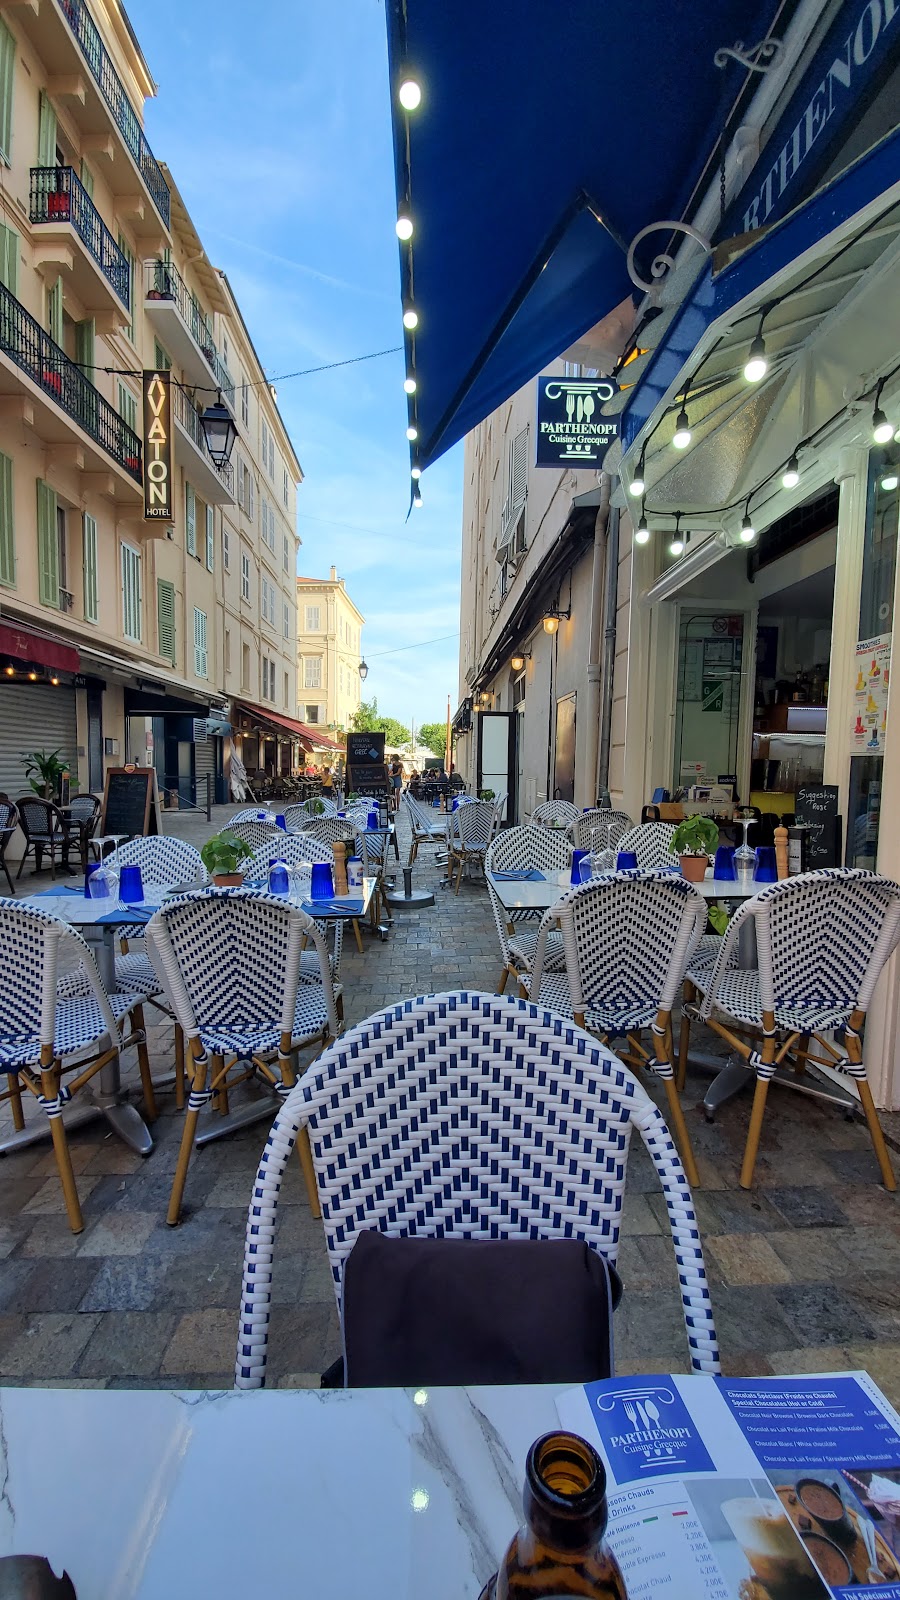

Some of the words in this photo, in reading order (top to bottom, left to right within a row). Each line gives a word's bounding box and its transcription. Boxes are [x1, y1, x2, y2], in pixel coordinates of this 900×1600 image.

[733, 0, 900, 238] RTHENO
[540, 422, 617, 435] PARTHENOPI
[147, 373, 168, 504] AVATON
[548, 434, 576, 443] Cuisine
[577, 435, 608, 446] Grecque
[146, 508, 171, 516] HOTEL
[856, 638, 881, 651] SMOOTHIES
[797, 789, 836, 804] Suggestion
[812, 801, 830, 811] Rosé
[728, 1391, 757, 1399] Chocolats
[610, 1427, 692, 1448] PARTHENOPI
[623, 1441, 654, 1454] Cuisine
[654, 1440, 687, 1450] Grecque
[608, 1496, 627, 1508] ssons
[627, 1487, 655, 1500] Chauds
[611, 1503, 637, 1517] Drinks
[612, 1535, 635, 1550] xpresso
[637, 1551, 666, 1565] Expresso
